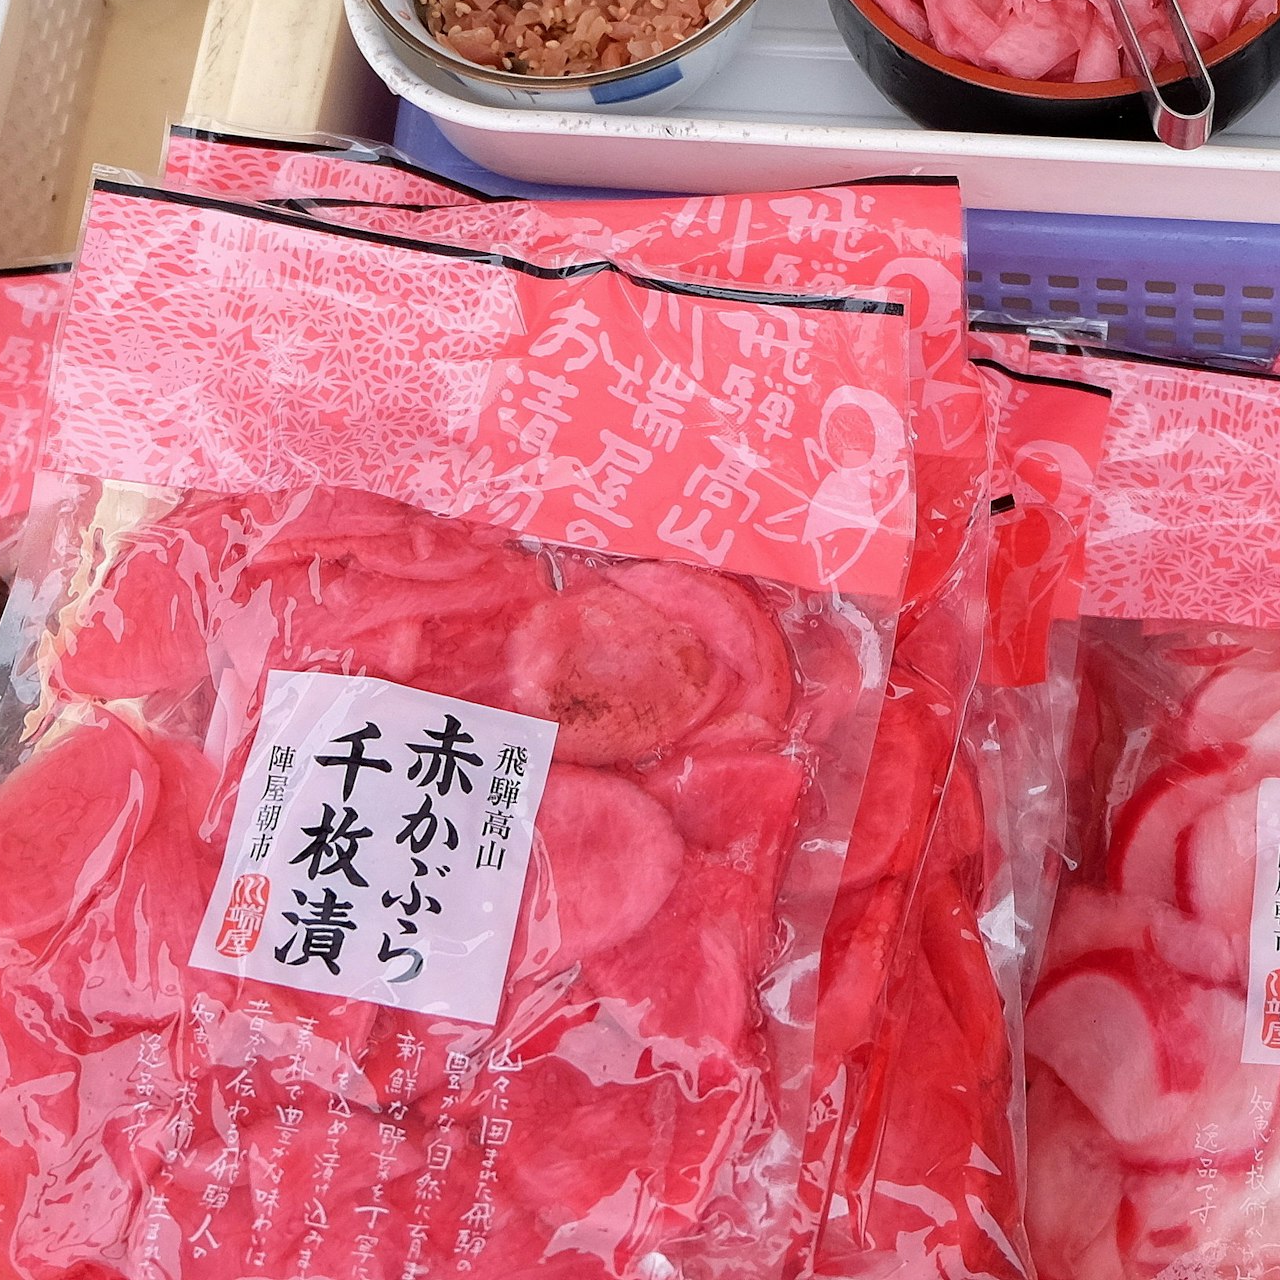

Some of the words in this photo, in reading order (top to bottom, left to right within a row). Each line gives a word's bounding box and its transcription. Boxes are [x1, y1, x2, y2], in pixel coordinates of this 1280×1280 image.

[565, 291, 704, 548] 川端屋の
[658, 306, 819, 566] 飛騨高山
[249, 745, 297, 862] 陣屋朝市
[274, 721, 393, 975] 千枚漬
[378, 714, 484, 983] 赤かぶら
[475, 742, 529, 871] 飛騨高山
[189, 999, 272, 1259] 昔から伝わる飛騨人の
[454, 1038, 523, 1272] 山々に囲まれた飛騨の
